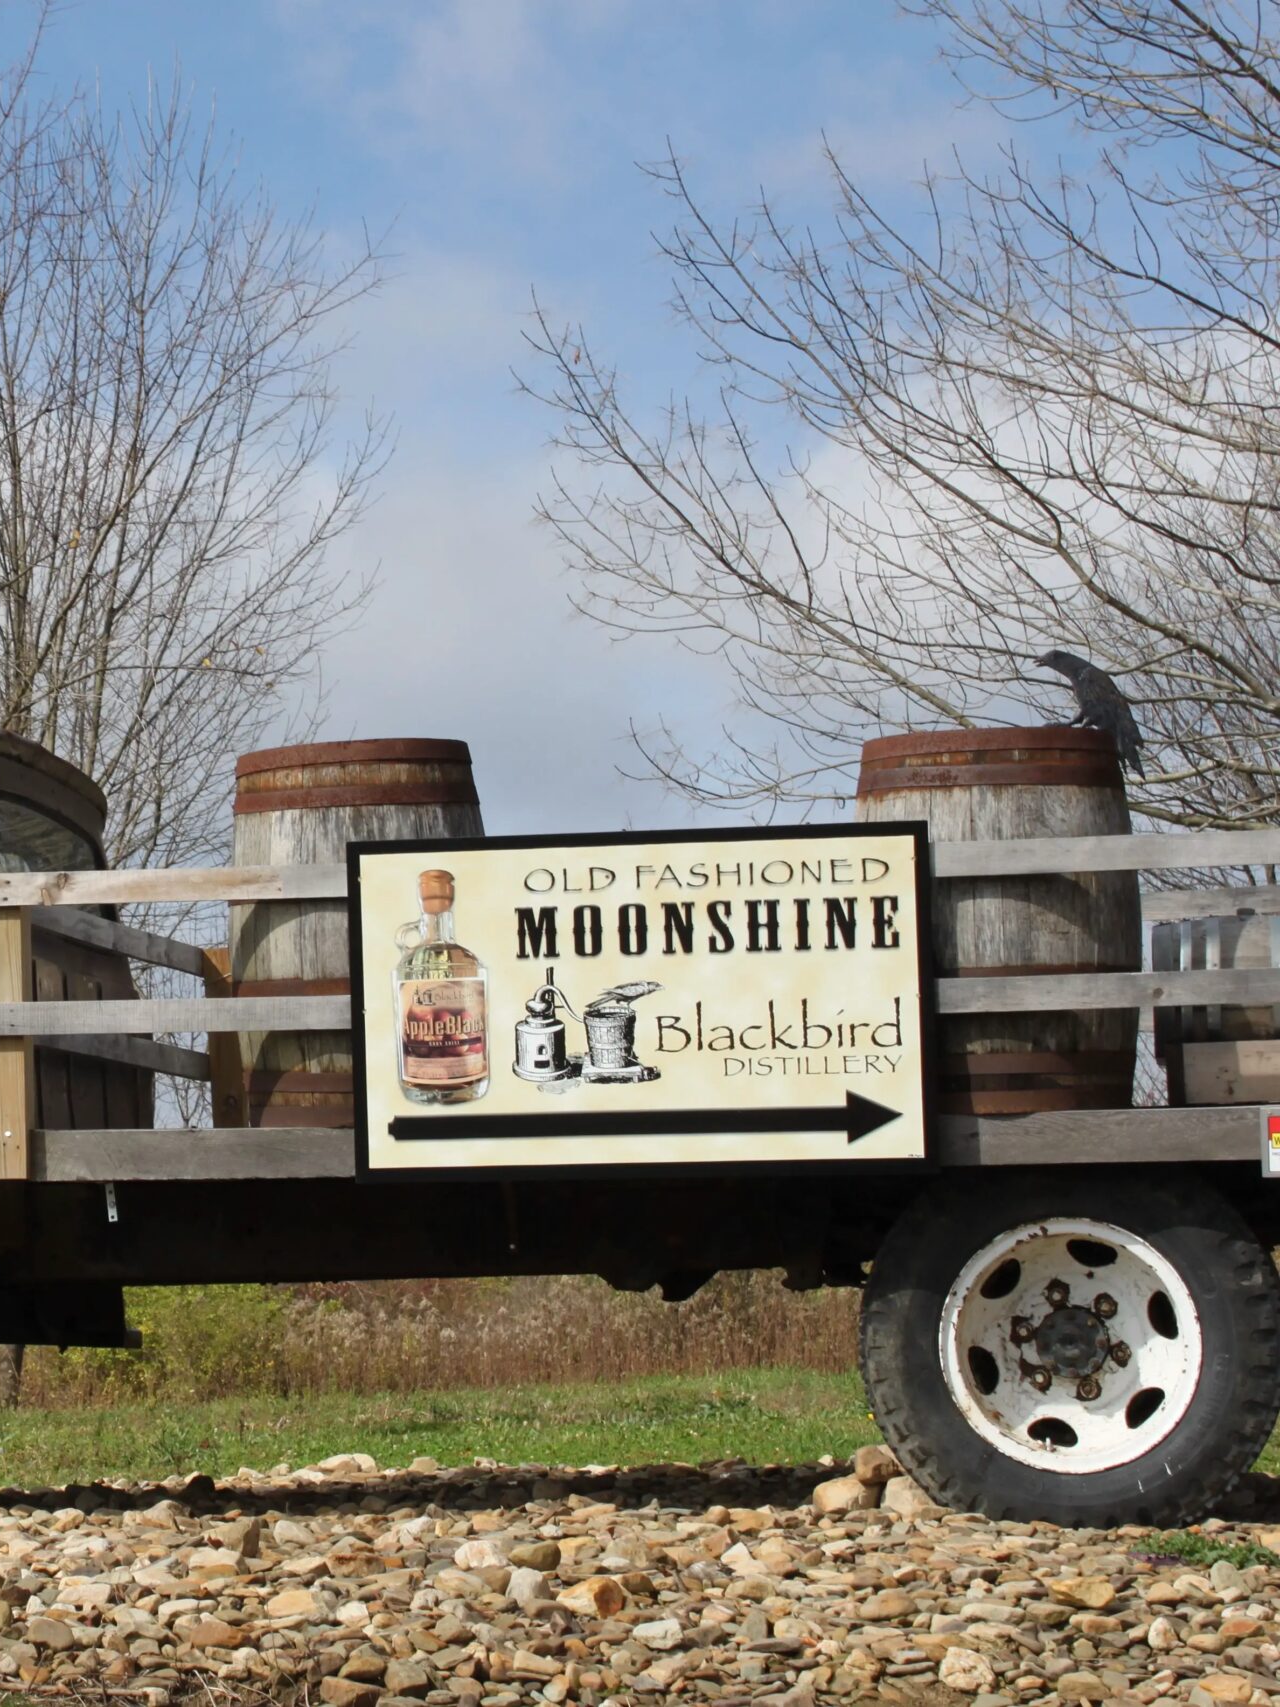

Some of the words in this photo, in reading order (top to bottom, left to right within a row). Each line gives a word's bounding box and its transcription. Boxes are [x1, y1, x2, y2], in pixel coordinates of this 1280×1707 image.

[523, 867, 616, 894] OLD
[636, 857, 890, 890] FASHIONED
[515, 895, 900, 960] MOONSHINE
[654, 996, 903, 1053] Blackbird
[723, 1054, 902, 1077] DISTILLERY
